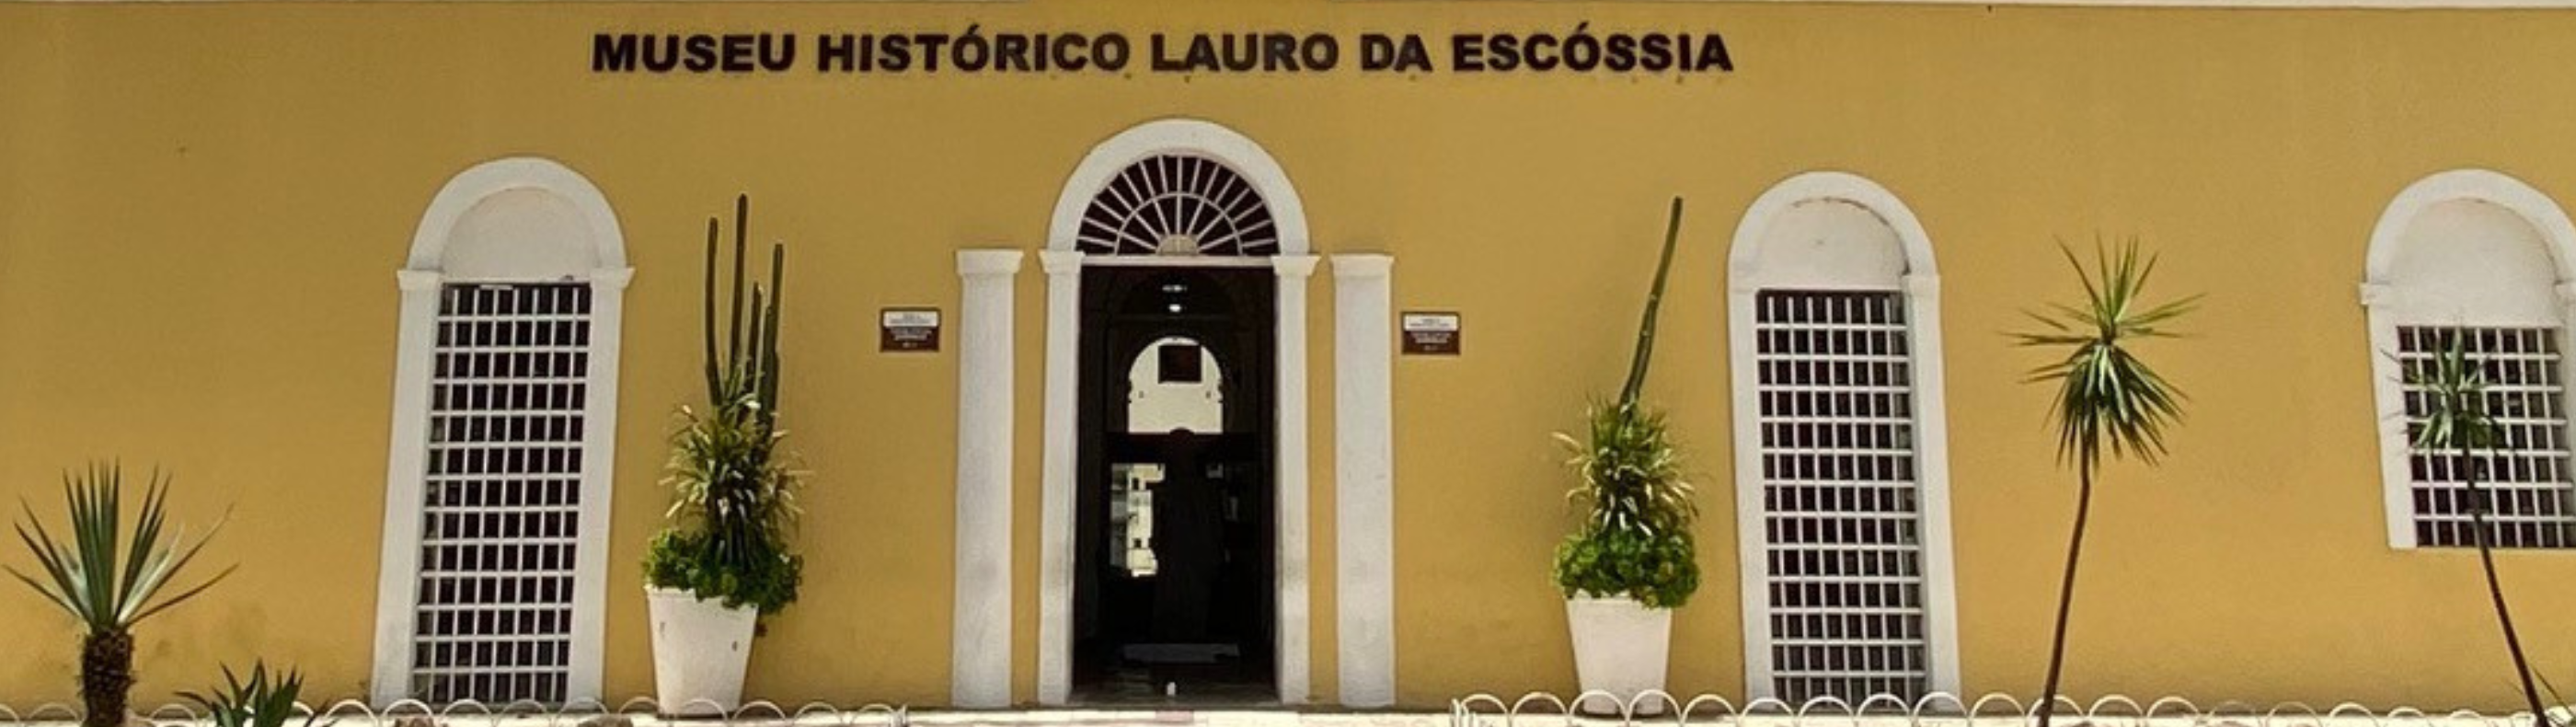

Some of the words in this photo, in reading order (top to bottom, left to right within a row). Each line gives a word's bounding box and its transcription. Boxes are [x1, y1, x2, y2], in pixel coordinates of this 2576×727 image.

[592, 33, 795, 73] MUSEU
[817, 24, 1129, 72] HISTÓRICO
[1151, 33, 1338, 72] LAURO
[1361, 34, 1432, 71] DA
[1452, 22, 1733, 71] ESCÓSSIA
